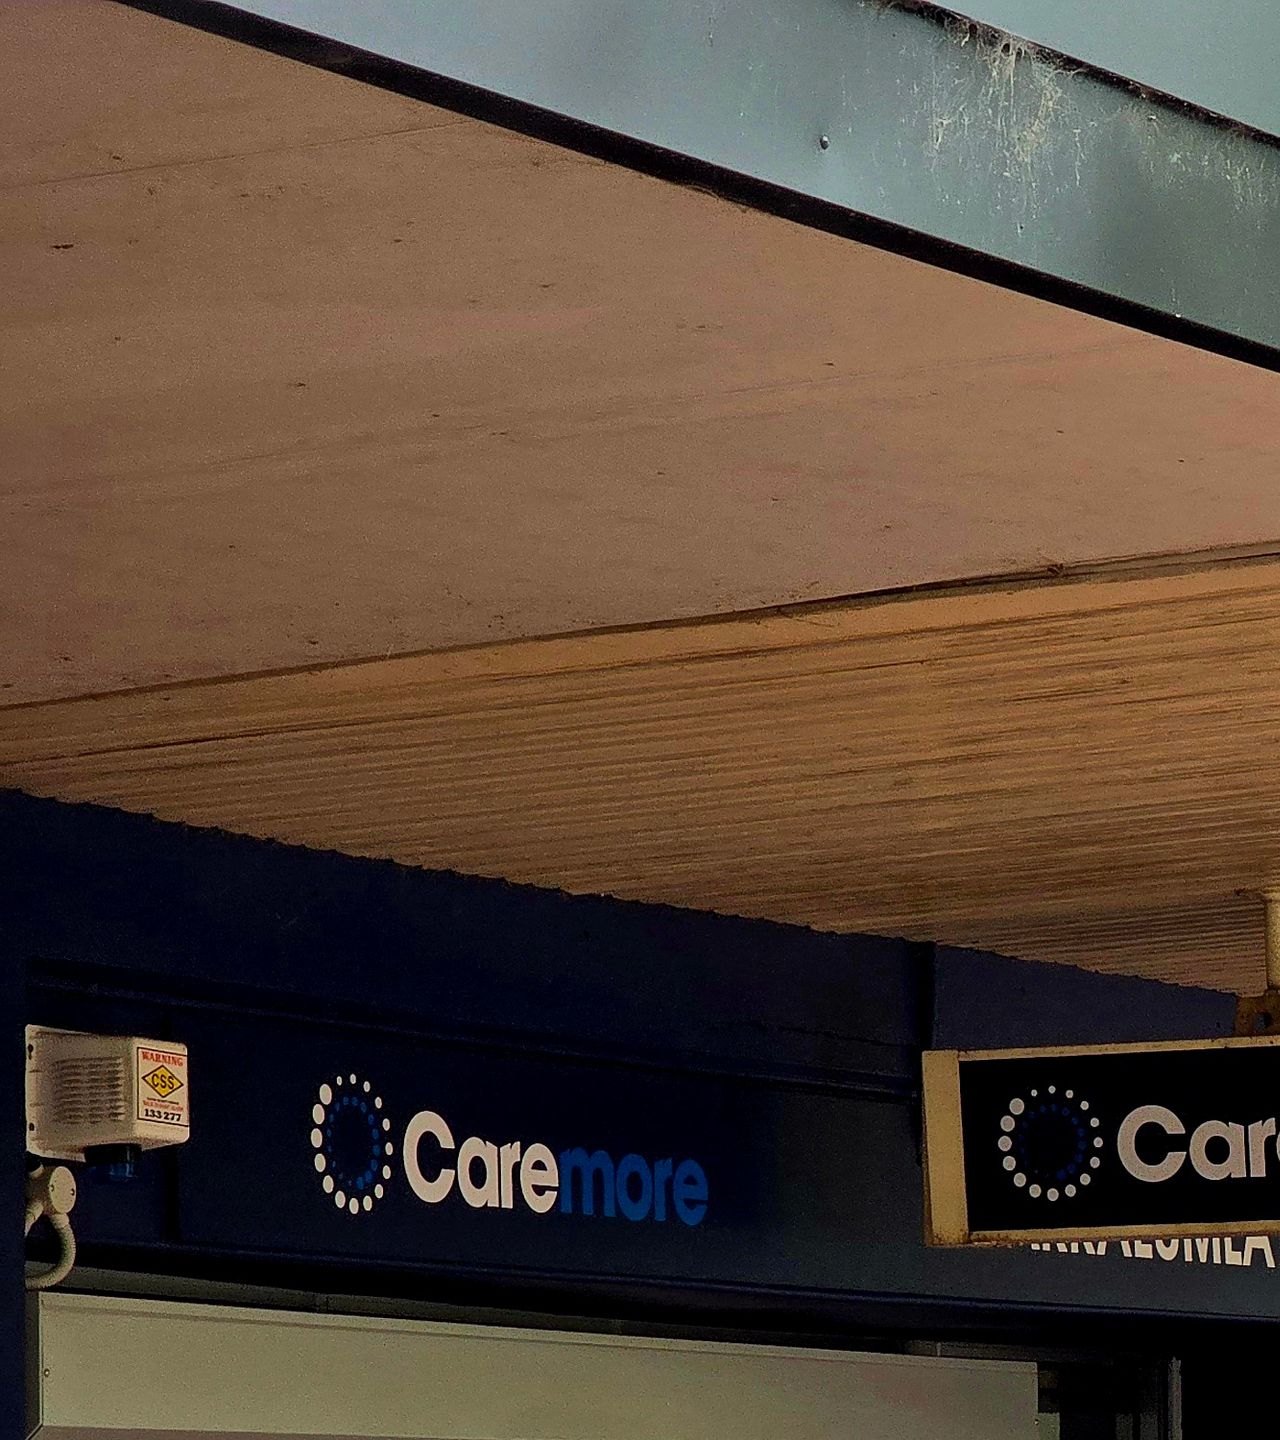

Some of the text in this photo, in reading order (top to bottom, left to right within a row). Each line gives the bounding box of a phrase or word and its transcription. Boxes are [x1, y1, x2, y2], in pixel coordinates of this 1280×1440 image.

[142, 1051, 184, 1067] WARNING
[151, 1073, 175, 1090] CSS
[402, 1110, 709, 1226] Caremore
